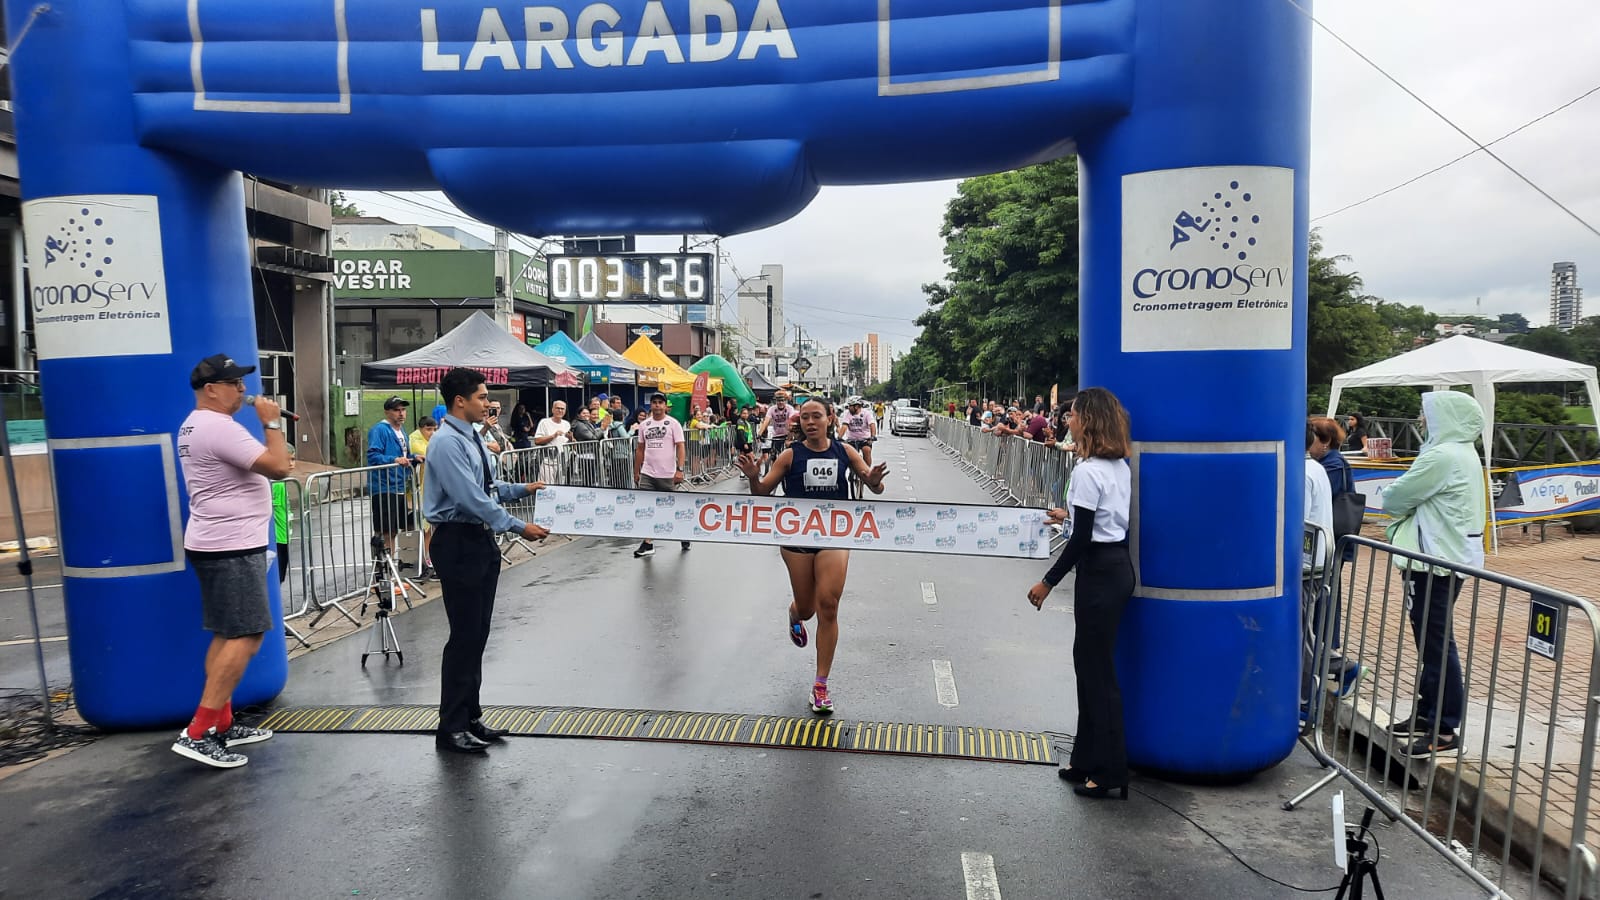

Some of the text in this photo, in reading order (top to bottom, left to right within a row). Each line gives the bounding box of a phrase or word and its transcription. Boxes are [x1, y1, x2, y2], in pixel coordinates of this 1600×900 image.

[420, 0, 798, 71] LARGADA
[334, 259, 403, 274] ORAR
[1133, 299, 1289, 312] Cronometragem Eletrônica
[98, 310, 161, 320] Eletrônica
[812, 467, 833, 476] 046
[699, 503, 881, 539] CHEGADA
[1536, 613, 1551, 637] 81
